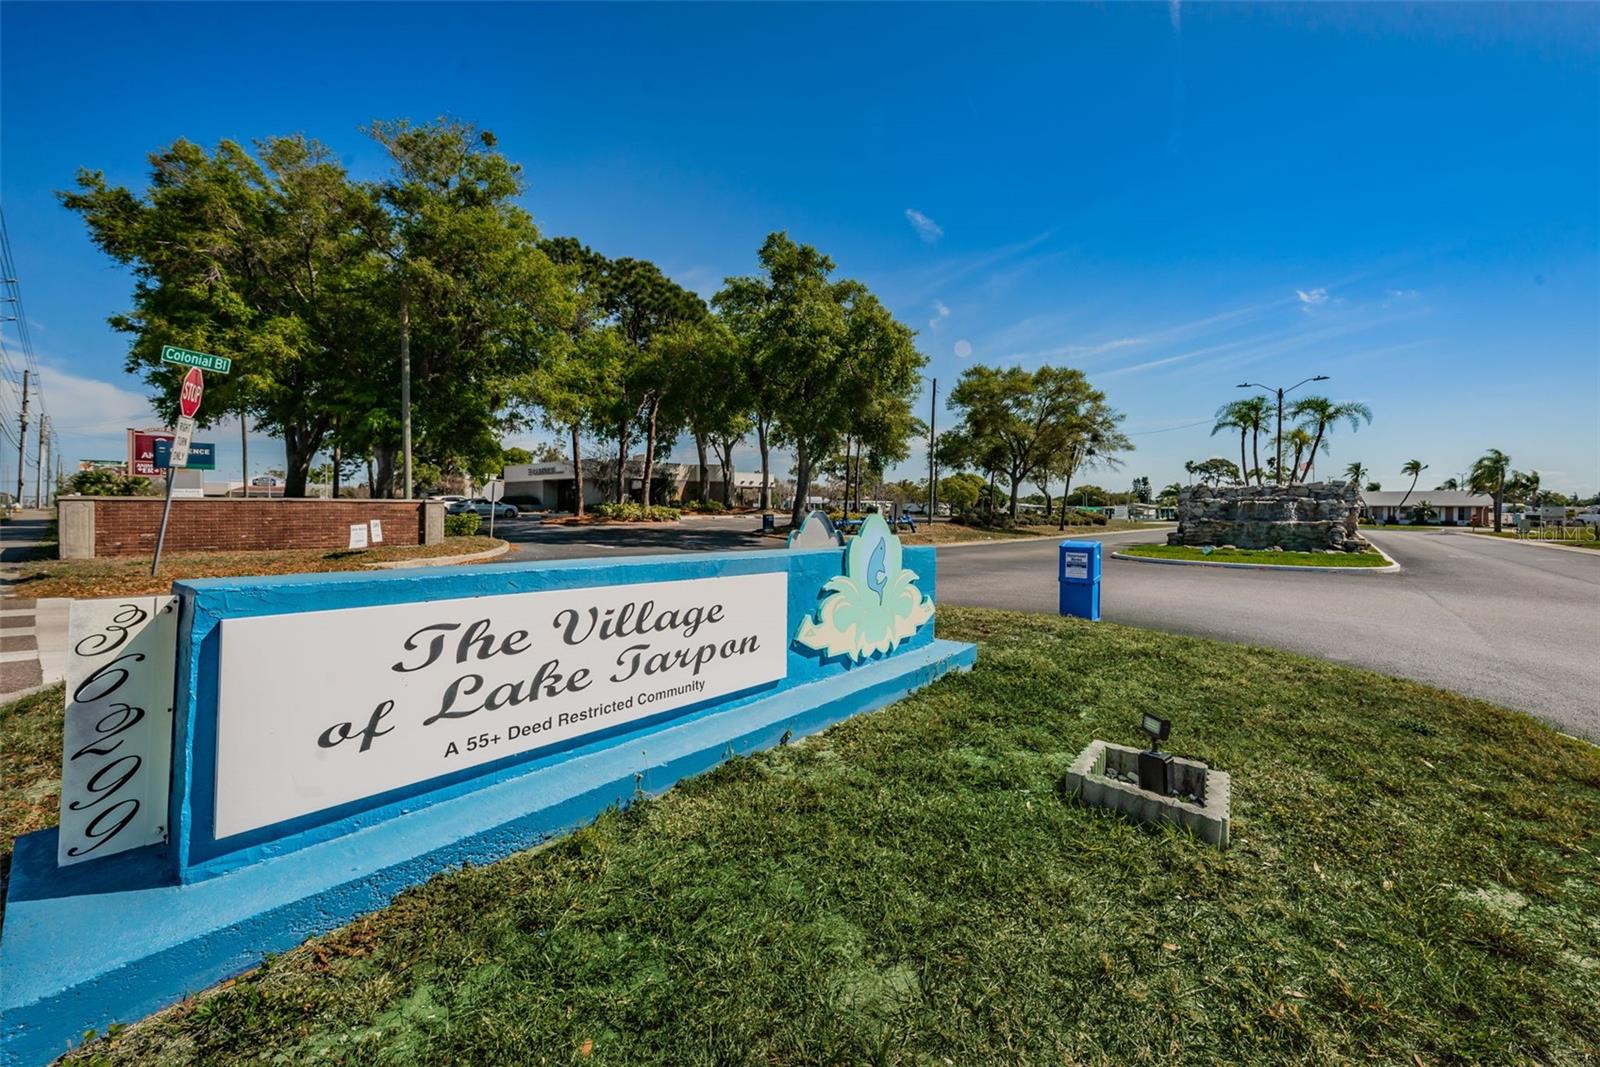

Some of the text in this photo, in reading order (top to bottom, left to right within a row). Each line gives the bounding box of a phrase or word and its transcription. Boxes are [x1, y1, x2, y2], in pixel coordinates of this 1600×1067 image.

[165, 348, 212, 367] Colonial
[183, 381, 201, 403] STOP
[391, 600, 726, 673] The Village
[67, 603, 148, 857] 36299
[317, 634, 761, 753] of Lake Tarpon
[443, 679, 706, 758] A 55+ Deed Restricted Community
